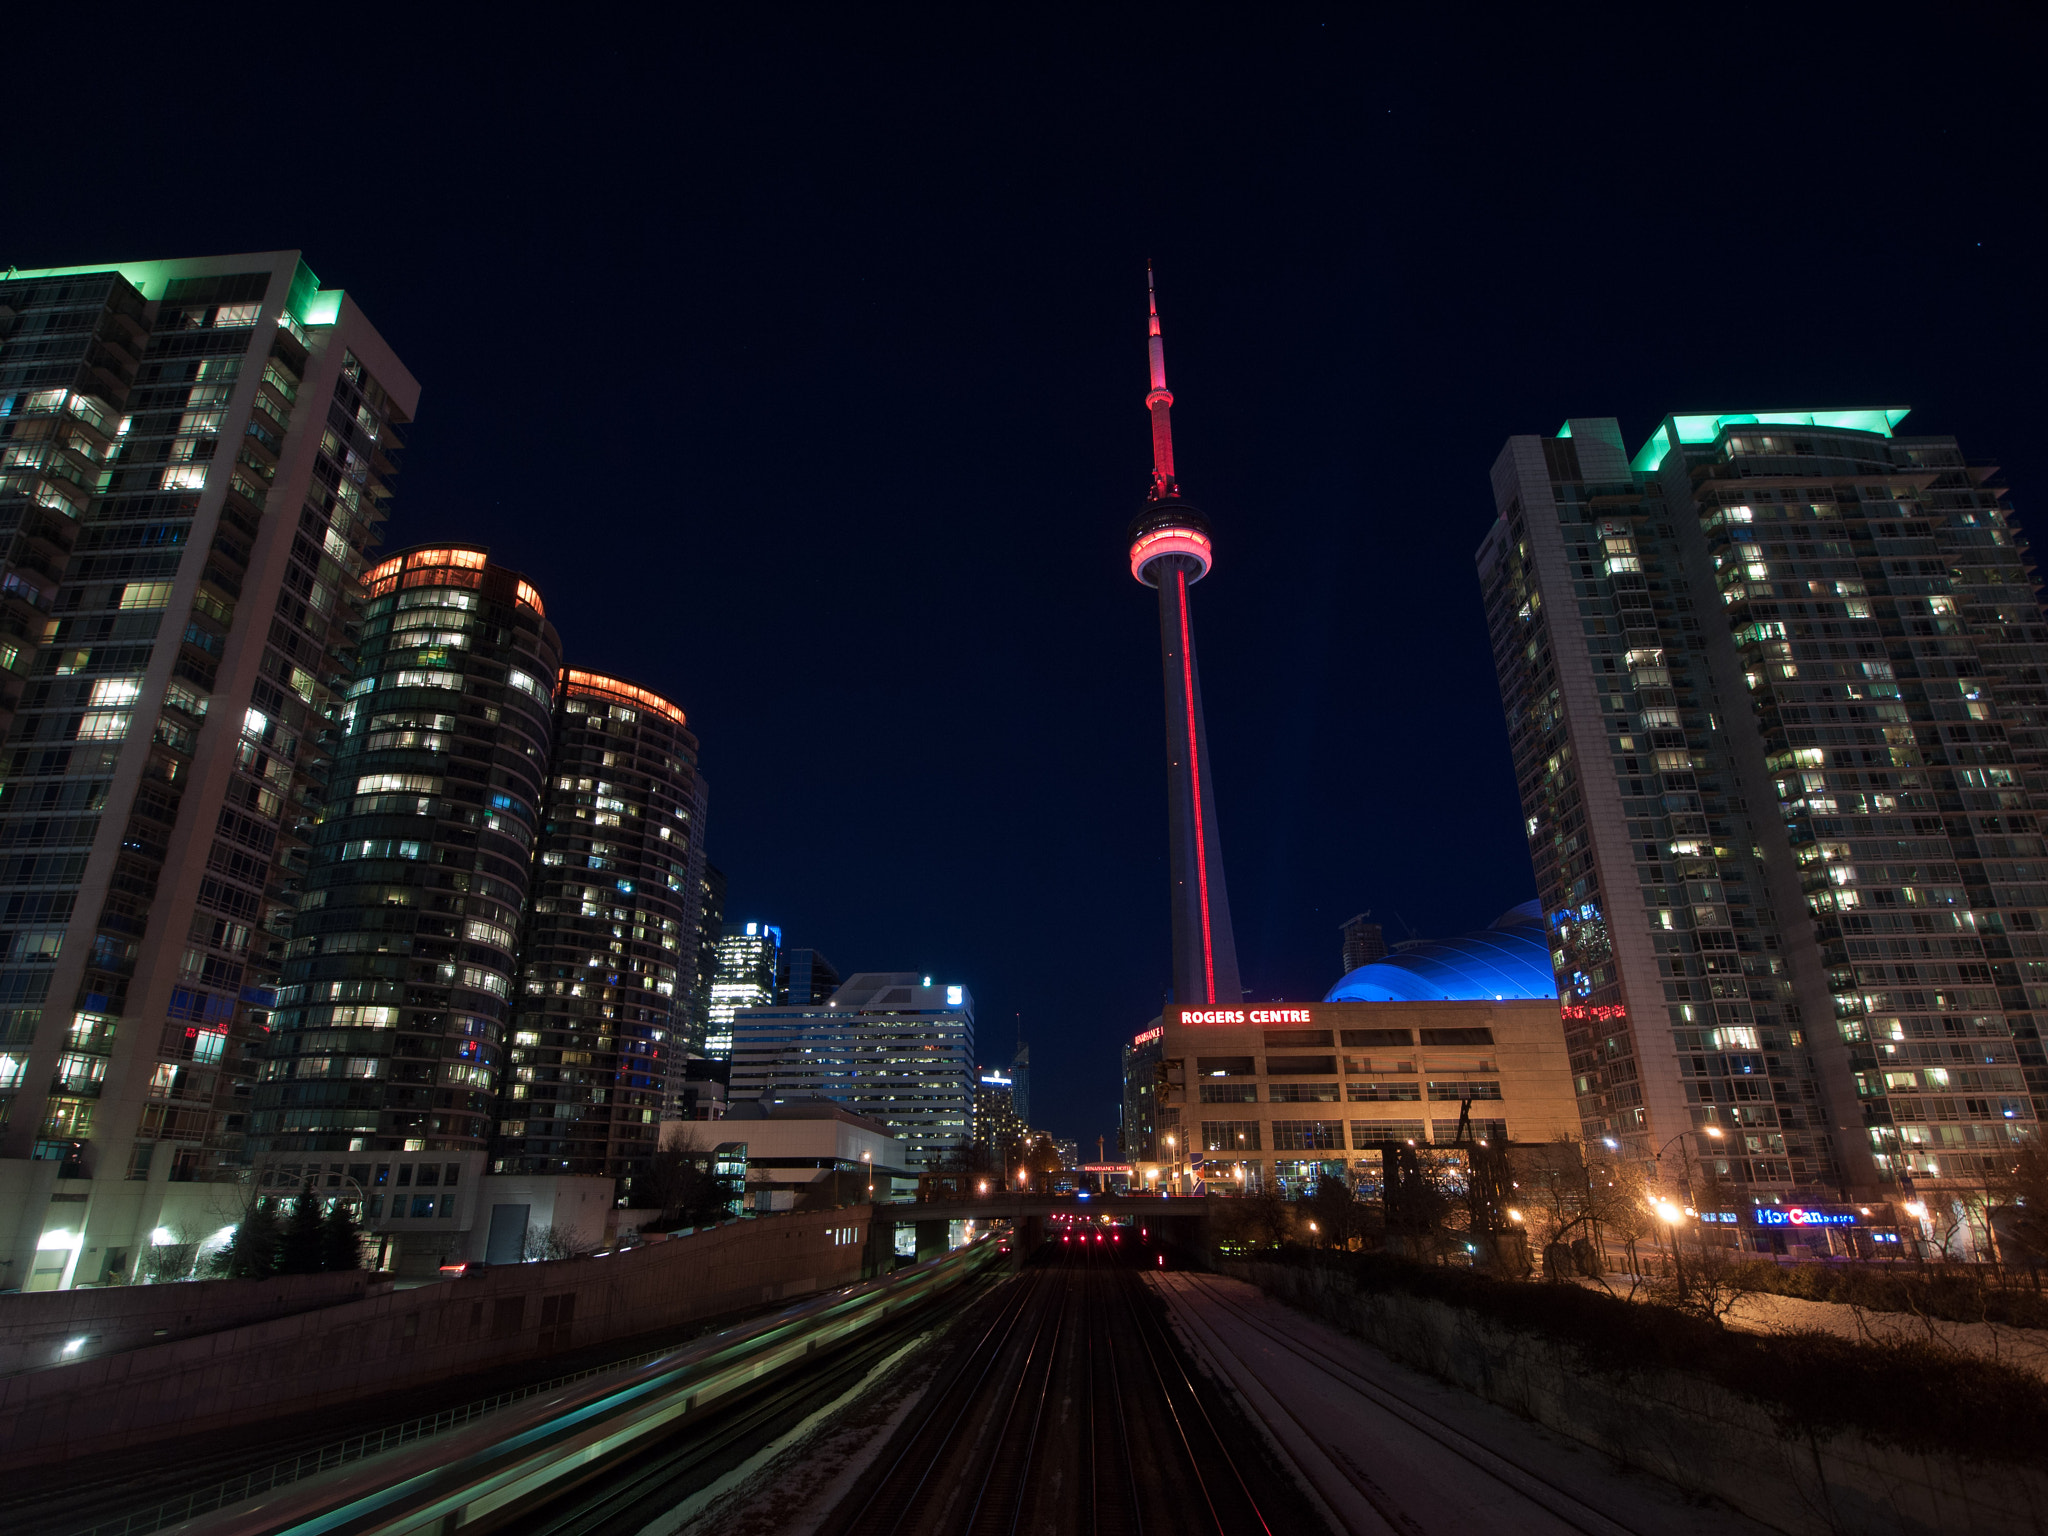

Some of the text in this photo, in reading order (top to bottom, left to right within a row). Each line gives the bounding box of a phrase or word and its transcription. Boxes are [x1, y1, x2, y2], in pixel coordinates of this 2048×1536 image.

[1181, 1010, 1310, 1023] ROGERS CENTRE
[1757, 1209, 1823, 1224] MorCan
